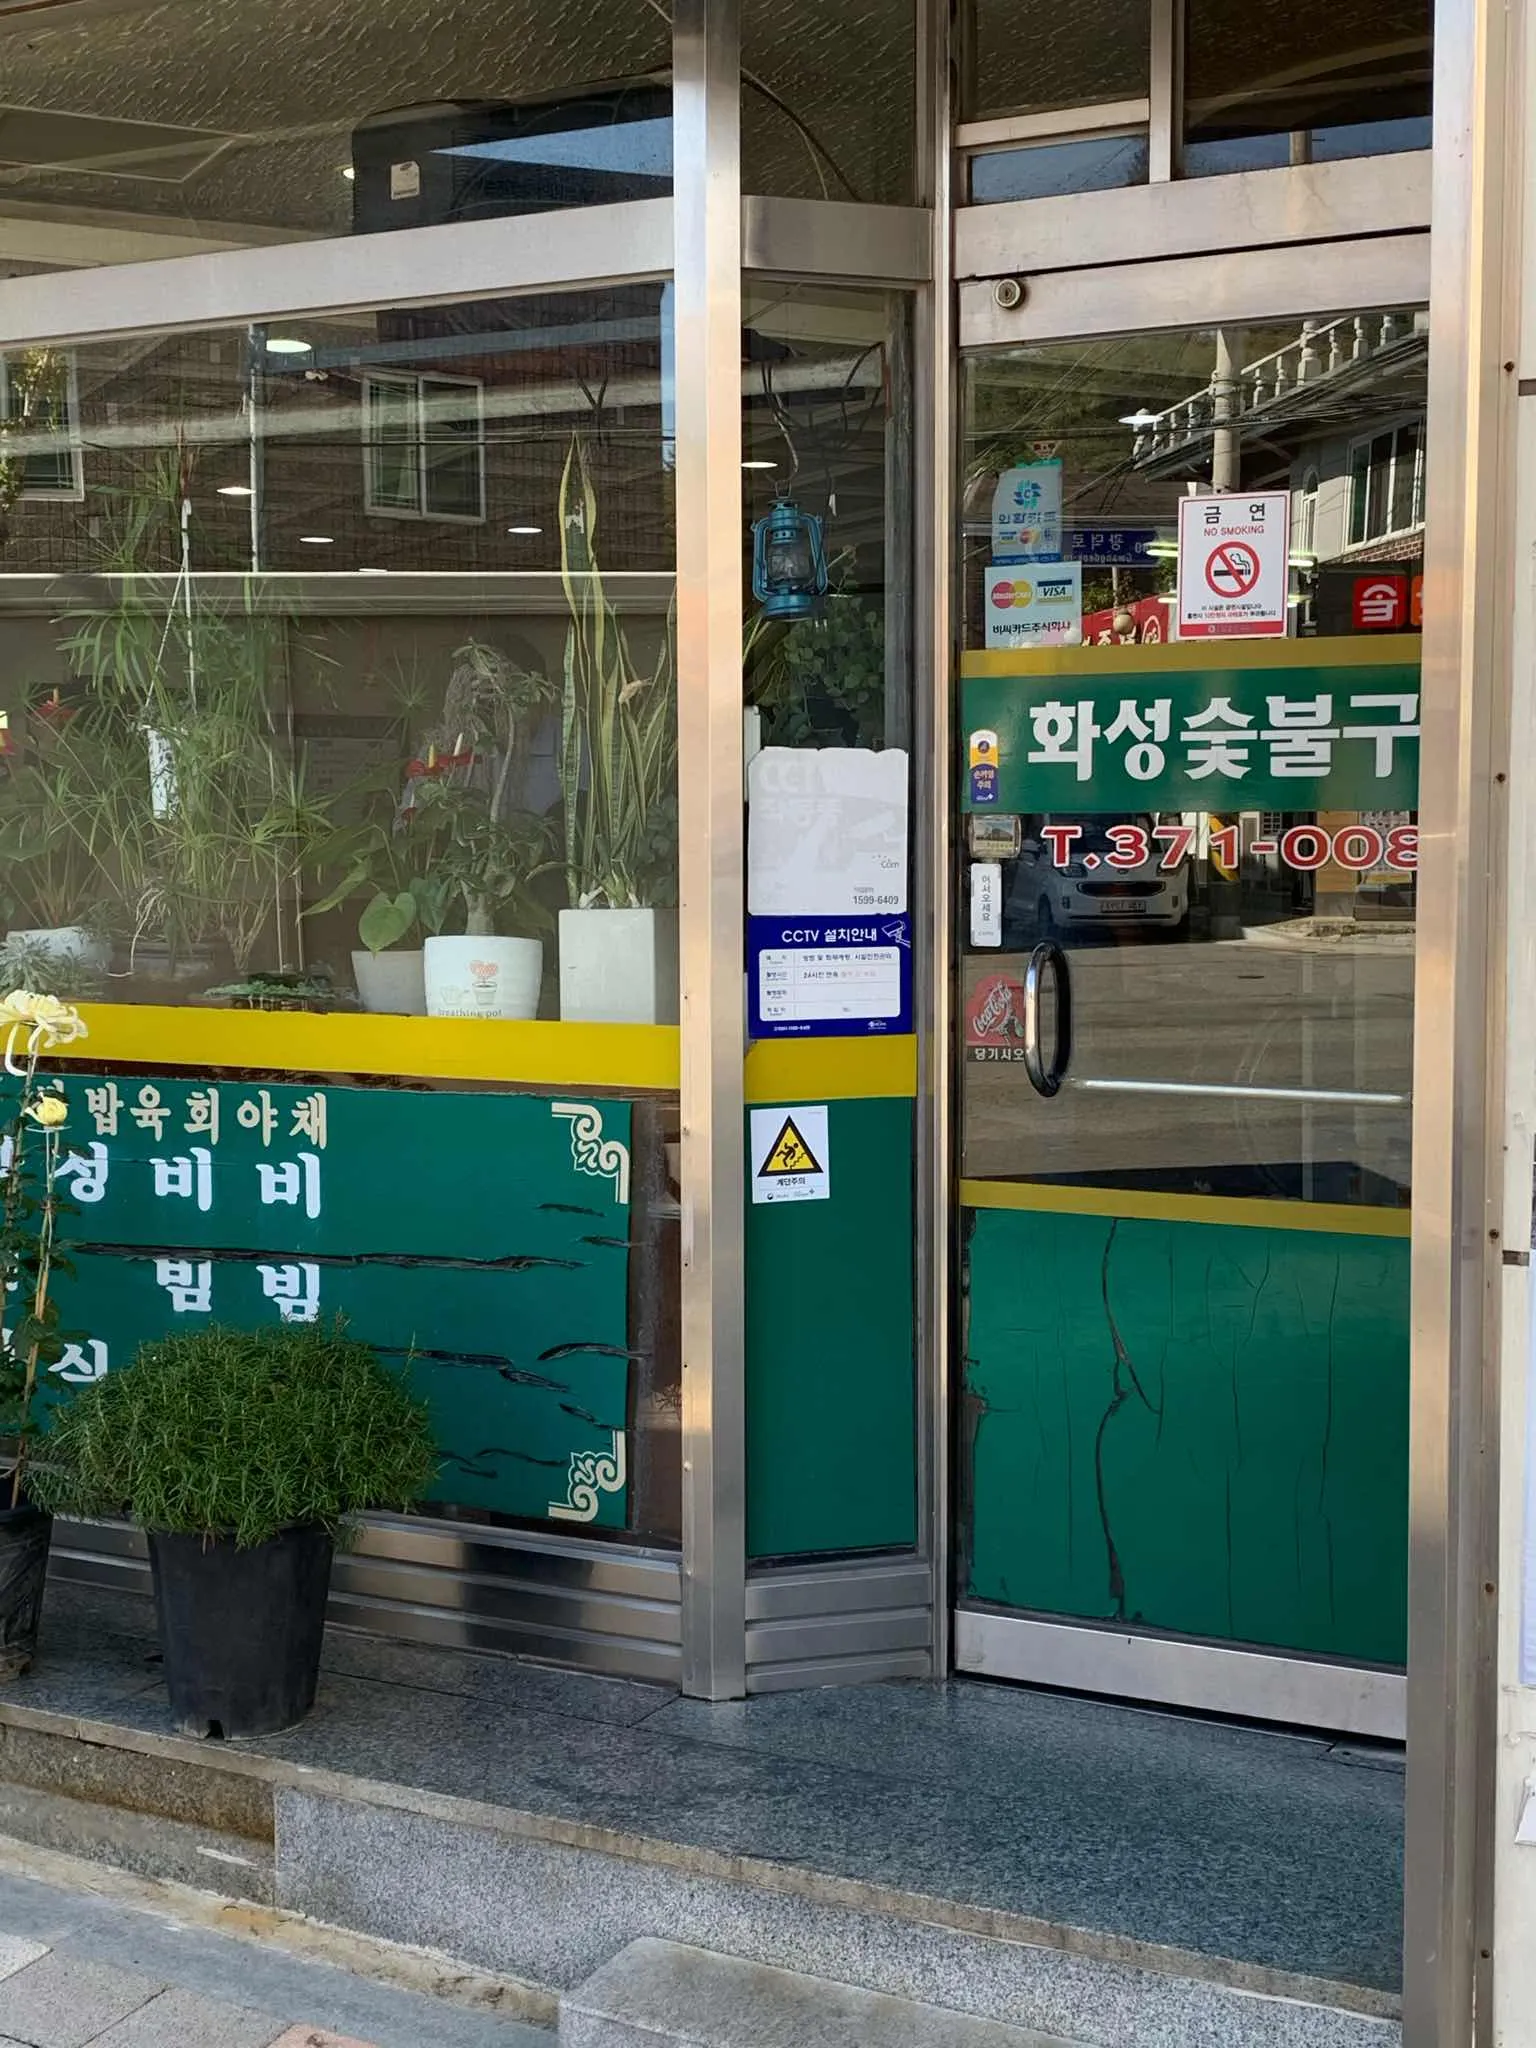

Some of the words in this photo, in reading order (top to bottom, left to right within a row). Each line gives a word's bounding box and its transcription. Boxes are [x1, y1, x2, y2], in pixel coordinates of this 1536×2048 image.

[1203, 527, 1218, 537] NO
[1221, 525, 1265, 536] SMOKING
[1043, 586, 1067, 597] VISA
[1027, 693, 1421, 783] 화성숯불구
[1040, 824, 1419, 871] T.371-008
[853, 895, 899, 905] 1599-6409
[980, 875, 992, 922] 어서오세요
[781, 930, 819, 942] CCTV
[823, 928, 877, 942] 설치안내
[974, 1047, 1025, 1061] 당기시오
[776, 1176, 806, 1187] 계단주의
